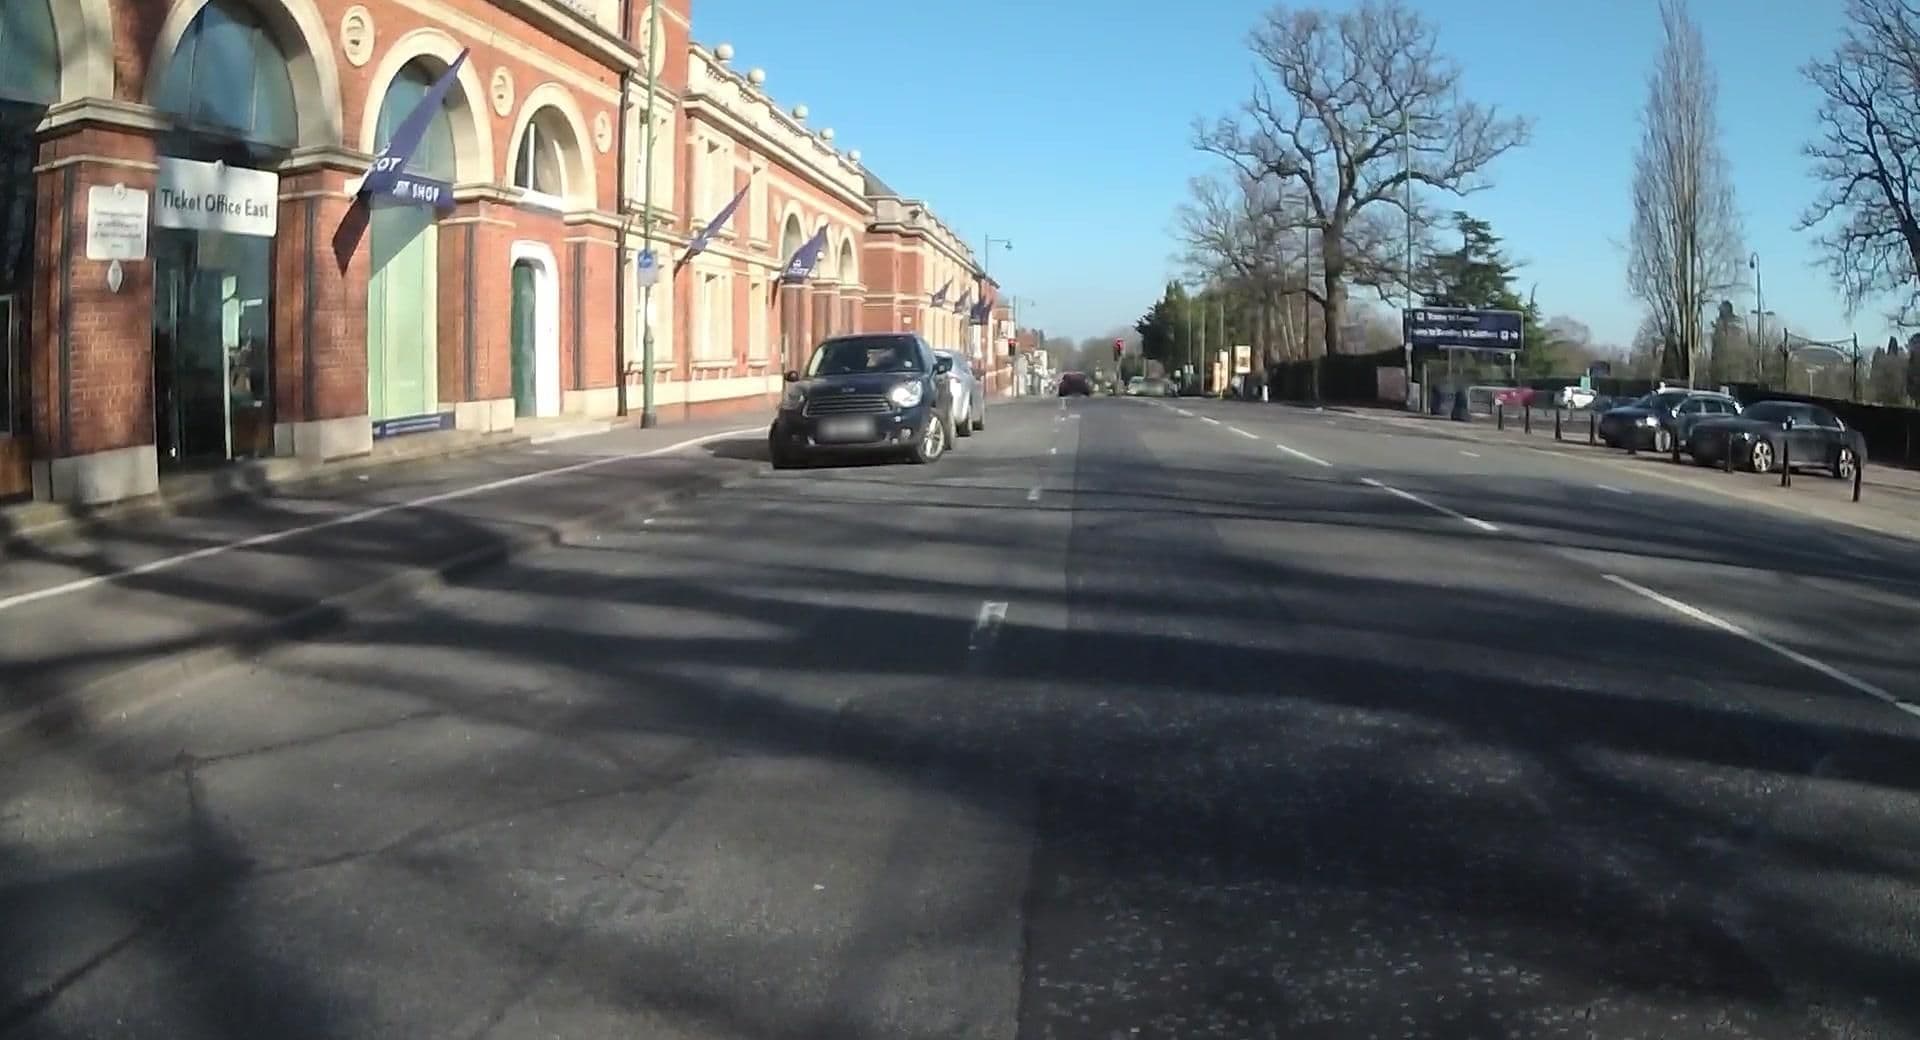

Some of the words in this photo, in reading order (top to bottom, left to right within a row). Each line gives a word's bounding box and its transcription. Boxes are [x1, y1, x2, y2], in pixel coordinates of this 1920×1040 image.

[161, 188, 201, 211] Ticket
[205, 194, 241, 215] Office
[245, 199, 269, 218] East
[412, 183, 439, 203] SHOP
